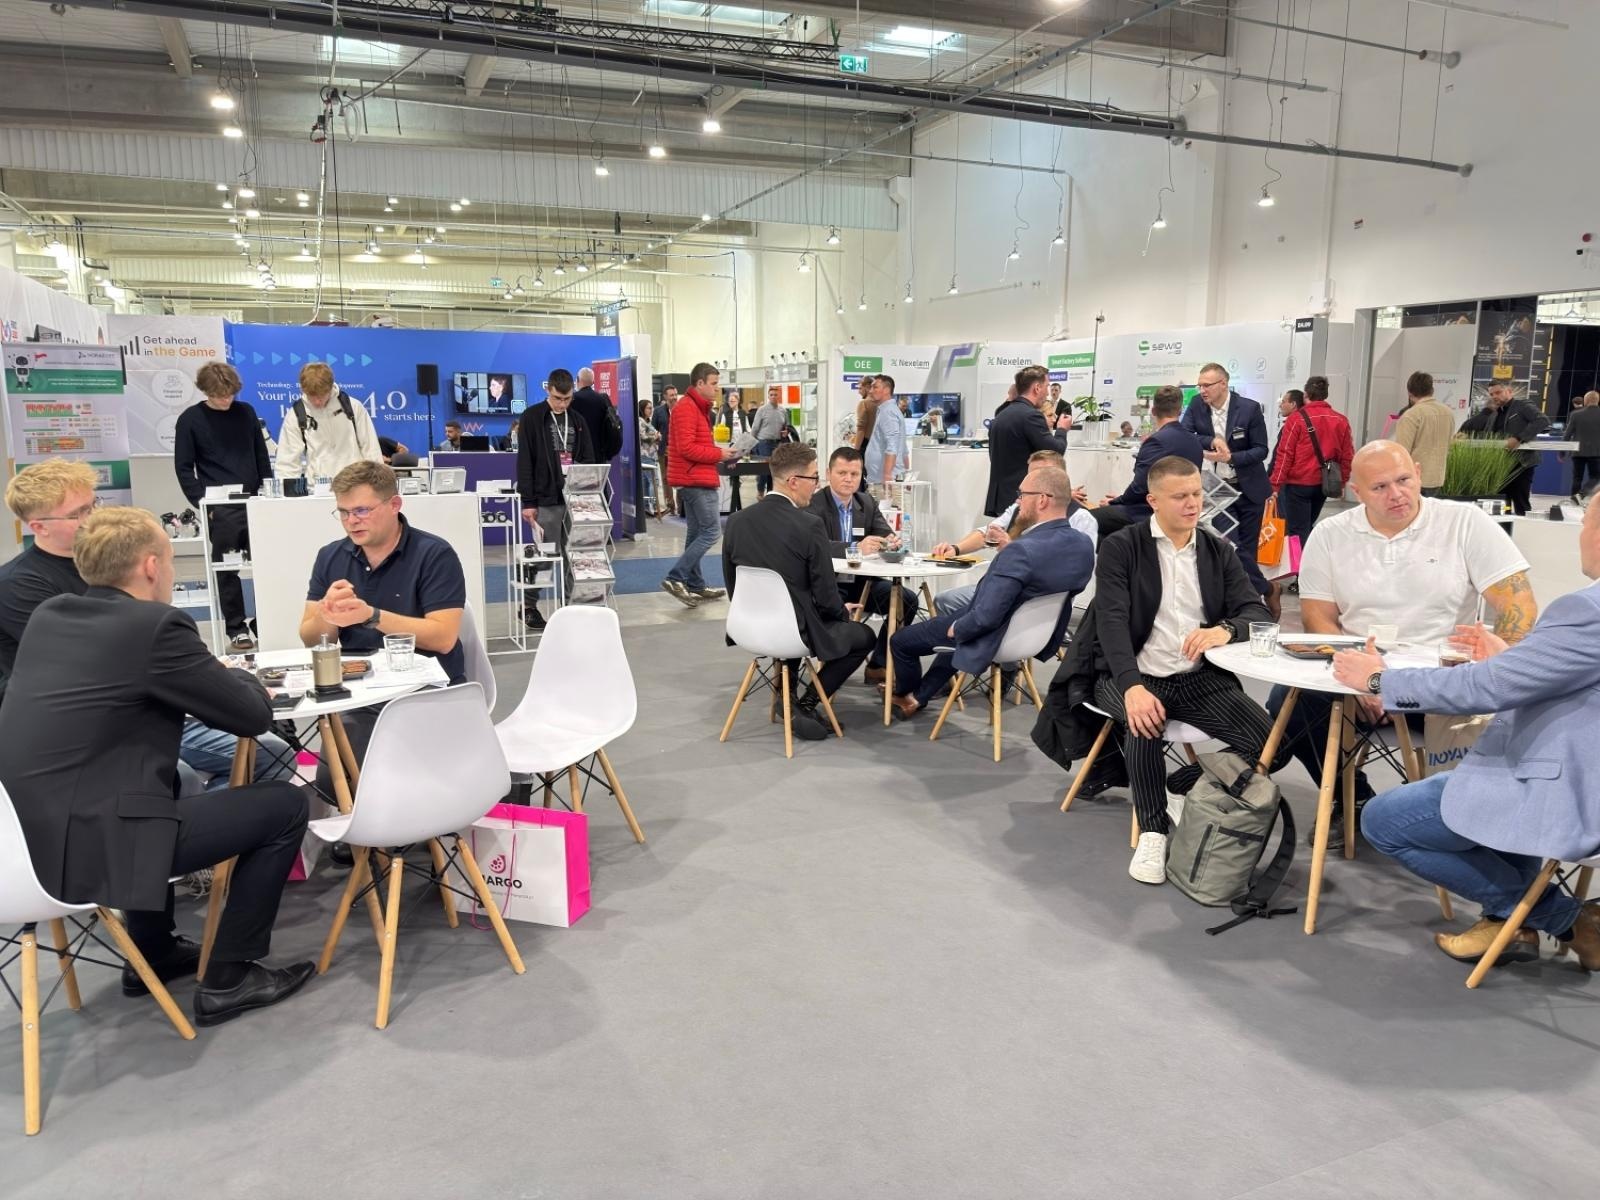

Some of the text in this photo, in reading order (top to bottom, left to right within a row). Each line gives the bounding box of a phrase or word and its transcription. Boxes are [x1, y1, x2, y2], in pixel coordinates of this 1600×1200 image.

[143, 335, 198, 346] Get ahead
[144, 349, 153, 357] in
[153, 347, 176, 357] the
[179, 347, 216, 357] Game
[854, 360, 872, 369] OEE
[899, 359, 930, 368] Nexelem
[997, 357, 1032, 366] Nexelem
[257, 391, 287, 401] Your
[384, 412, 436, 421] starts here
